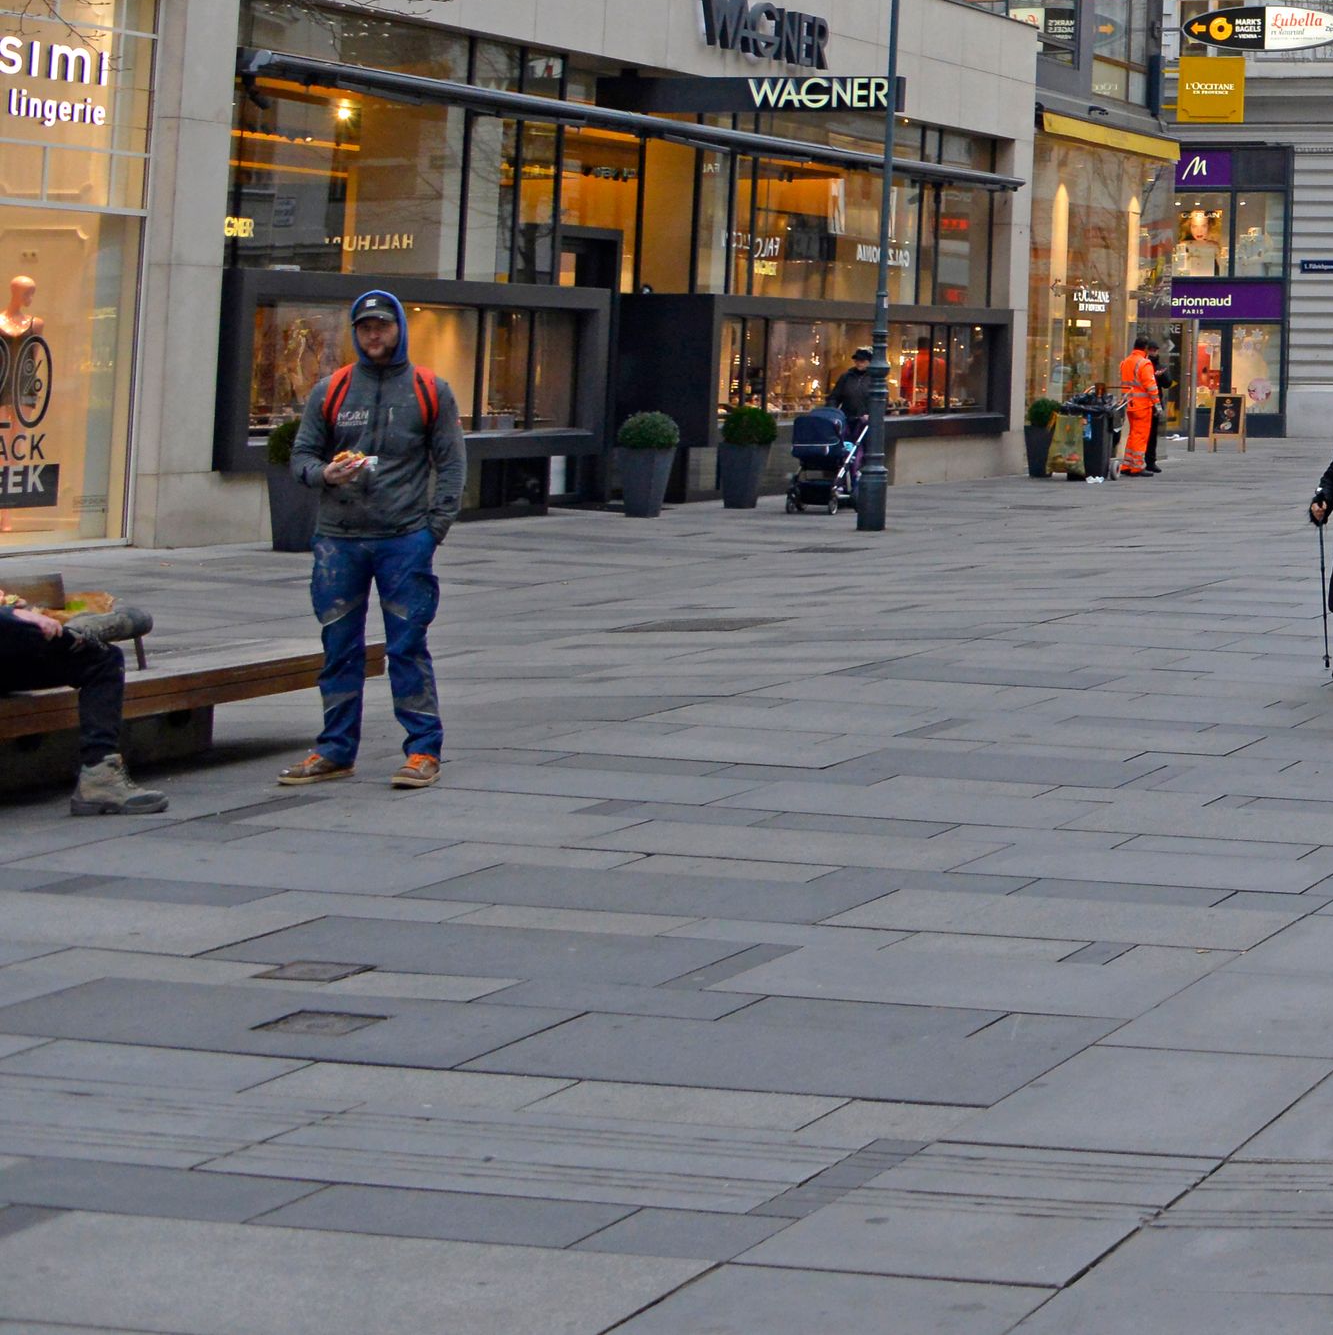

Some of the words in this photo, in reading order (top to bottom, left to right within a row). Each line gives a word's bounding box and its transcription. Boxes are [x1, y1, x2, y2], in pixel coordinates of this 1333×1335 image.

[1235, 18, 1261, 26] MARK'S
[1271, 12, 1323, 28] Lubella
[748, 77, 889, 108] WAGNER
[1186, 81, 1235, 91] L'OCCITANE
[8, 88, 106, 127] lingerie
